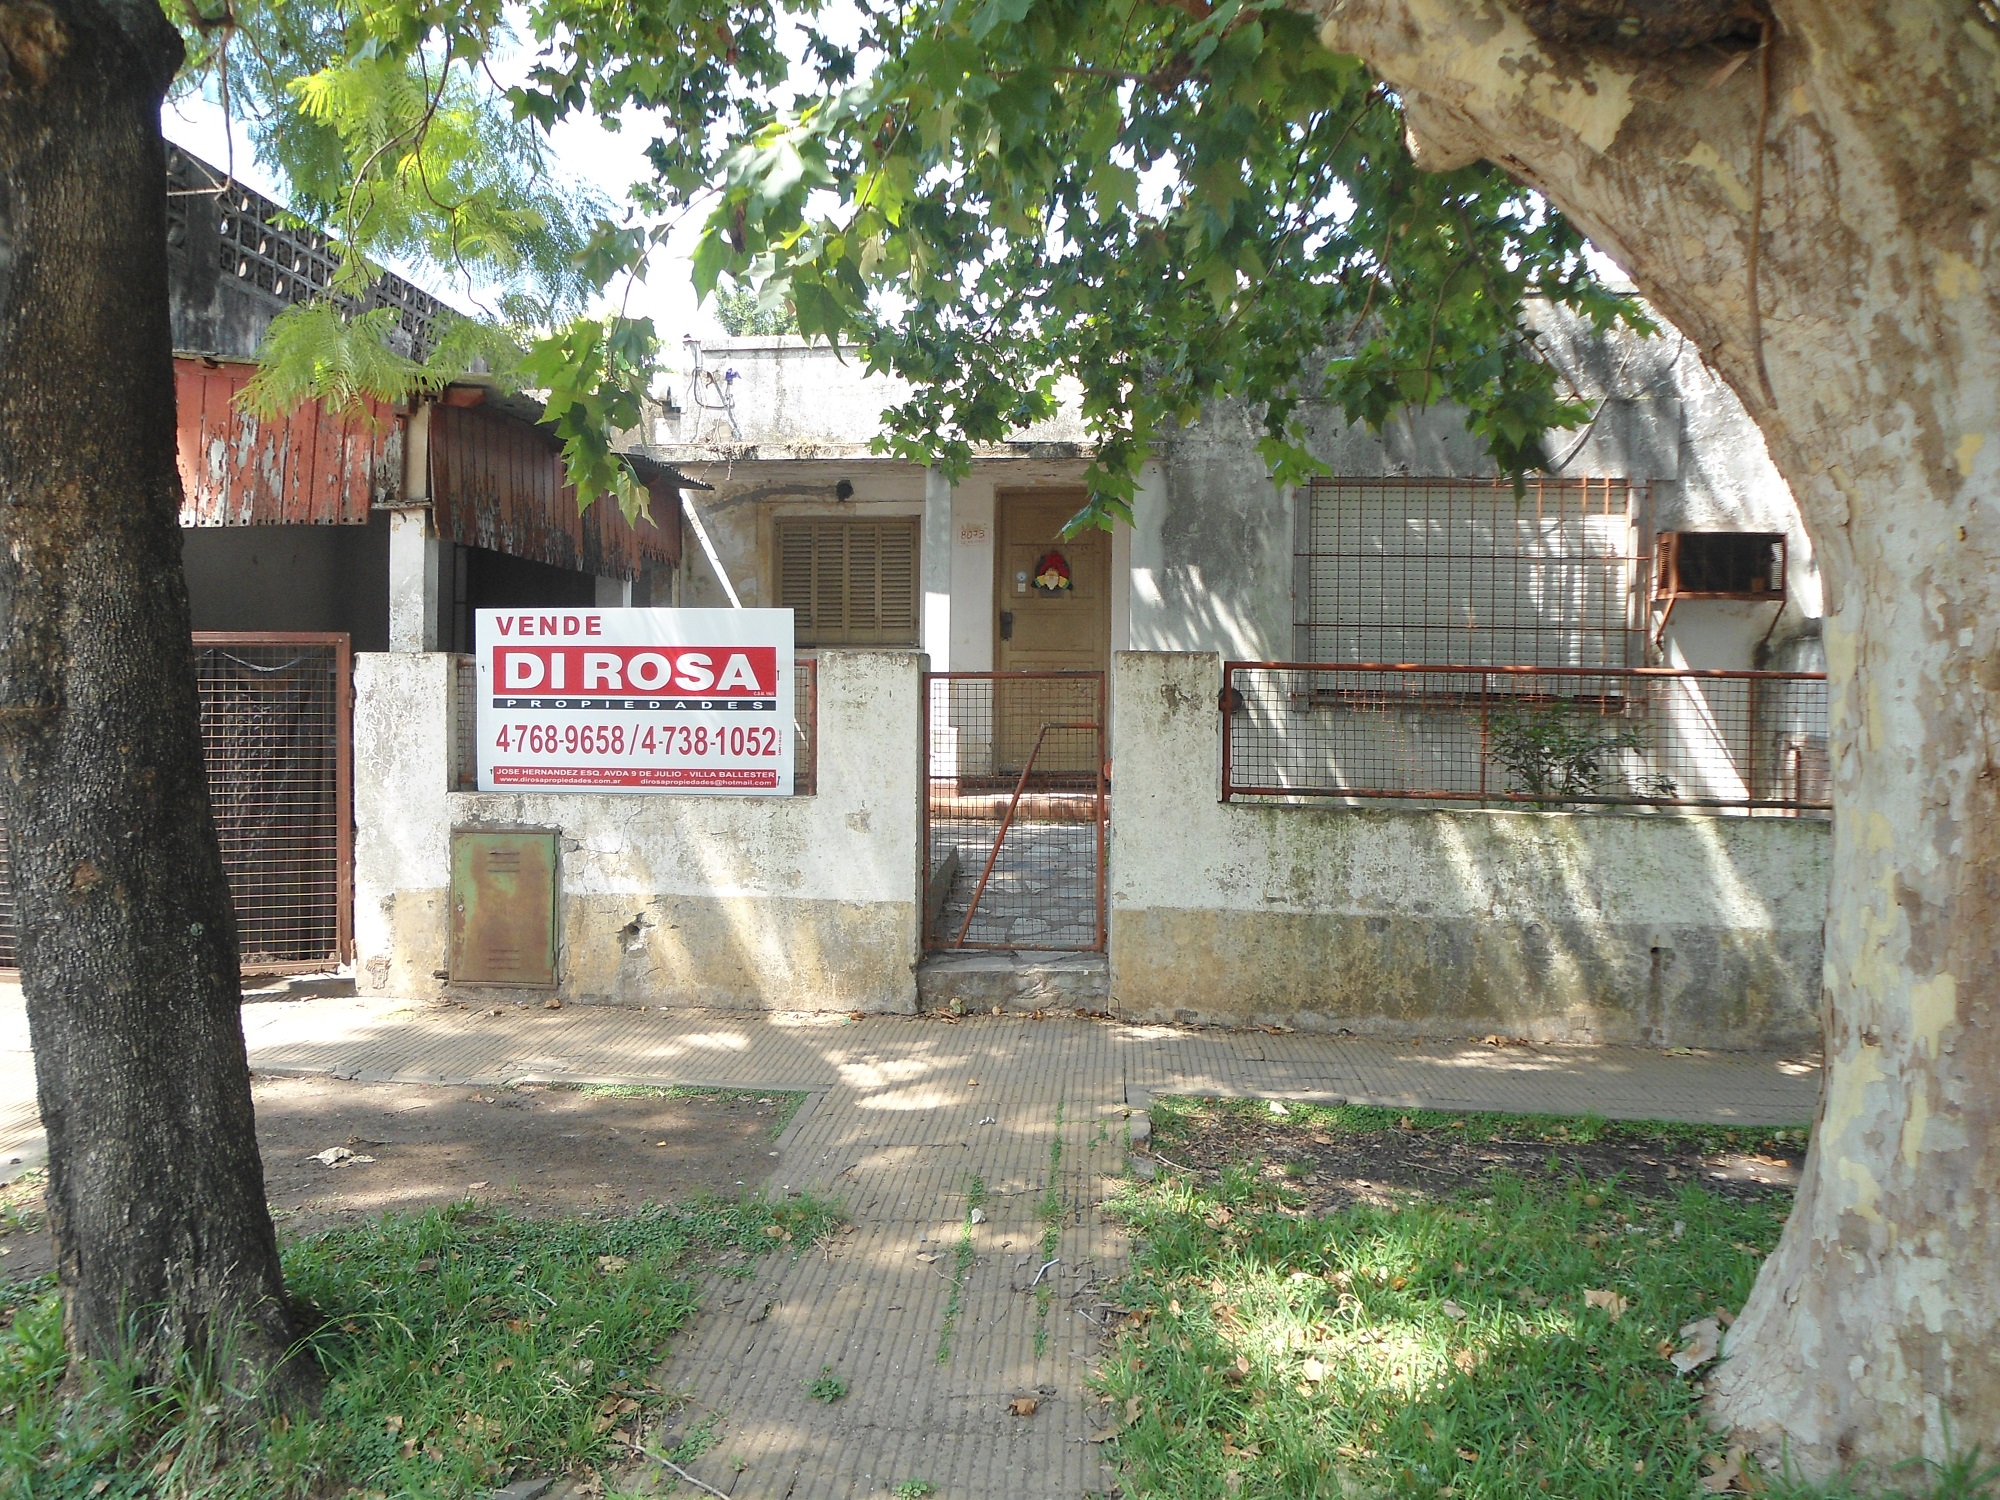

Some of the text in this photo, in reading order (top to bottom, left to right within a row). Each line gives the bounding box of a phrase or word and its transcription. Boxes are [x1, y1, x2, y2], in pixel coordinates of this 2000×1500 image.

[495, 615, 602, 636] VENDE
[505, 652, 761, 691] DI ROSA
[506, 699, 764, 710] PROPIEDADES
[522, 768, 578, 776] HERNANDEZ
[580, 769, 602, 777] ESQ.
[718, 771, 775, 779] BALLESTER
[499, 776, 772, 787] www.dirosapropiedades.com.ar dirosapropiedades@hotmail.com
